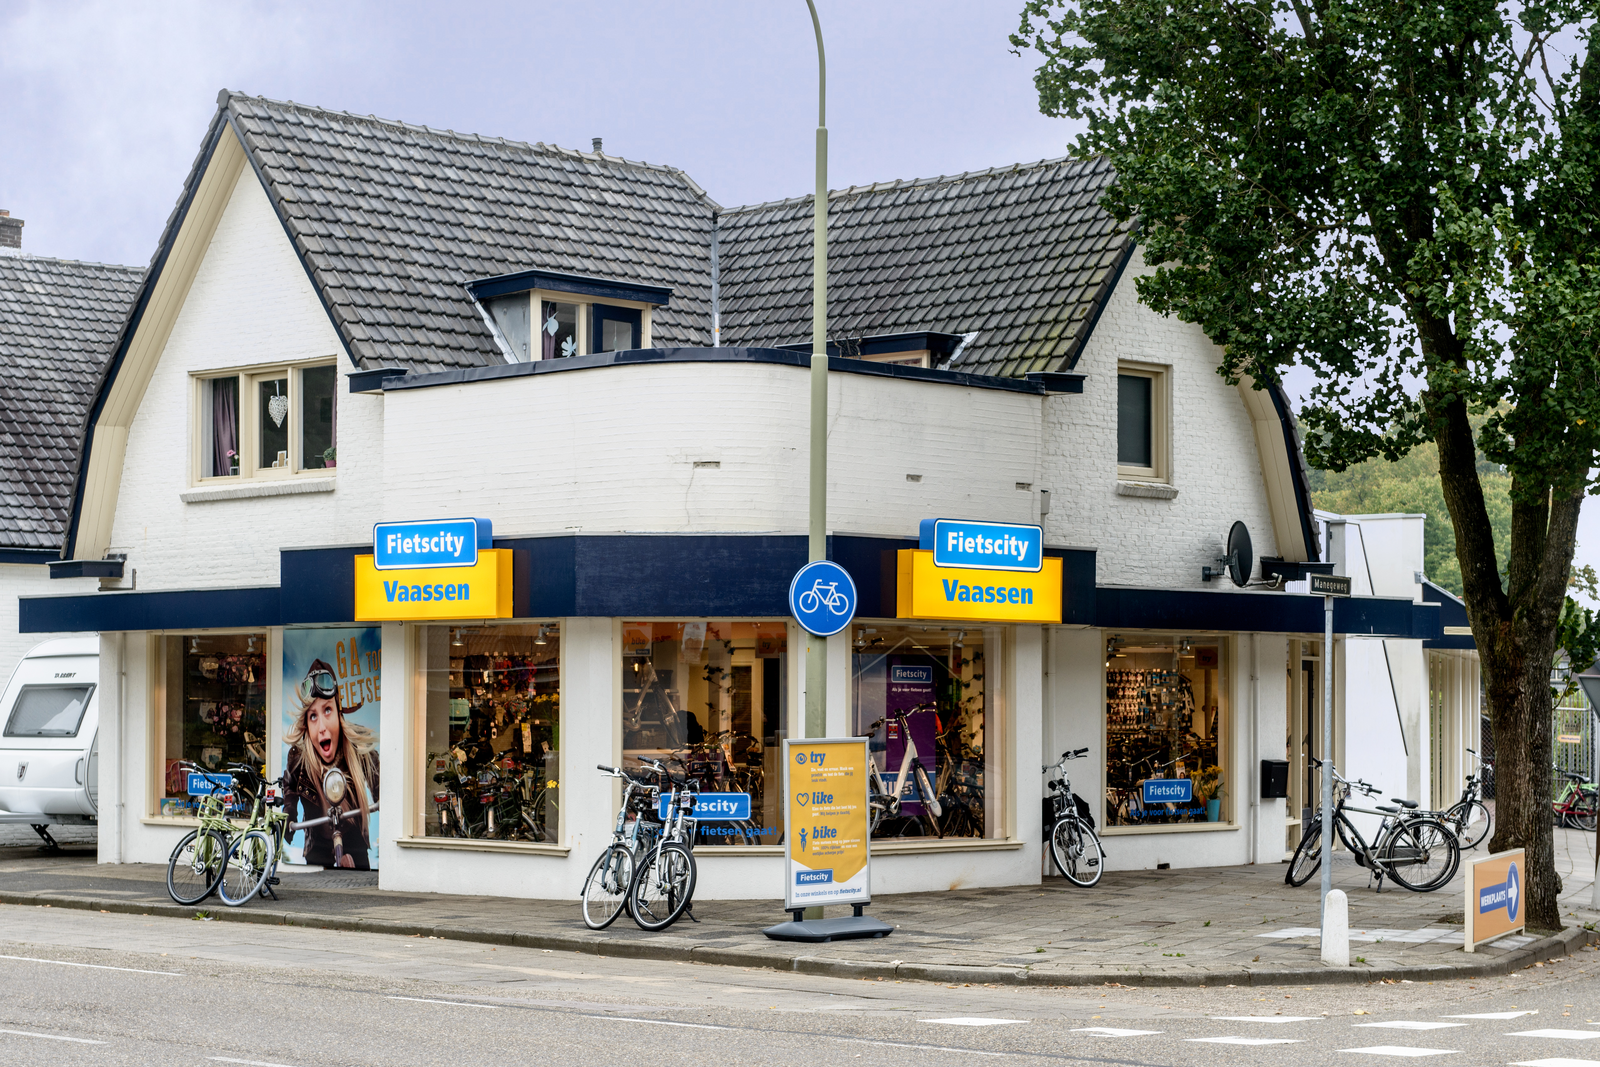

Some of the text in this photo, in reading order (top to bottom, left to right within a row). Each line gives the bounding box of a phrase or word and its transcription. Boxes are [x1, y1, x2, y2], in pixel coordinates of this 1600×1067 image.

[386, 532, 464, 557] Fietscity
[947, 532, 1029, 560] Fietscity
[383, 580, 470, 602] Vaassen
[942, 579, 1033, 605] Vaassen
[1314, 578, 1348, 593] Manegeweg
[336, 636, 362, 679] GA
[896, 670, 927, 680] Fietscity
[810, 751, 826, 766] try
[812, 792, 834, 804] like
[1149, 785, 1186, 797] Fietscity
[694, 800, 738, 814] tscity
[1130, 809, 1140, 817] Als
[1141, 808, 1148, 818] je
[1166, 807, 1187, 816] fietsen
[1188, 807, 1206, 817] gaat!
[701, 826, 742, 836] fietsen
[746, 826, 777, 838] gaat!
[813, 826, 837, 839] bike
[800, 873, 828, 881] Fietscity
[1481, 890, 1506, 907] WERKPLAATS
